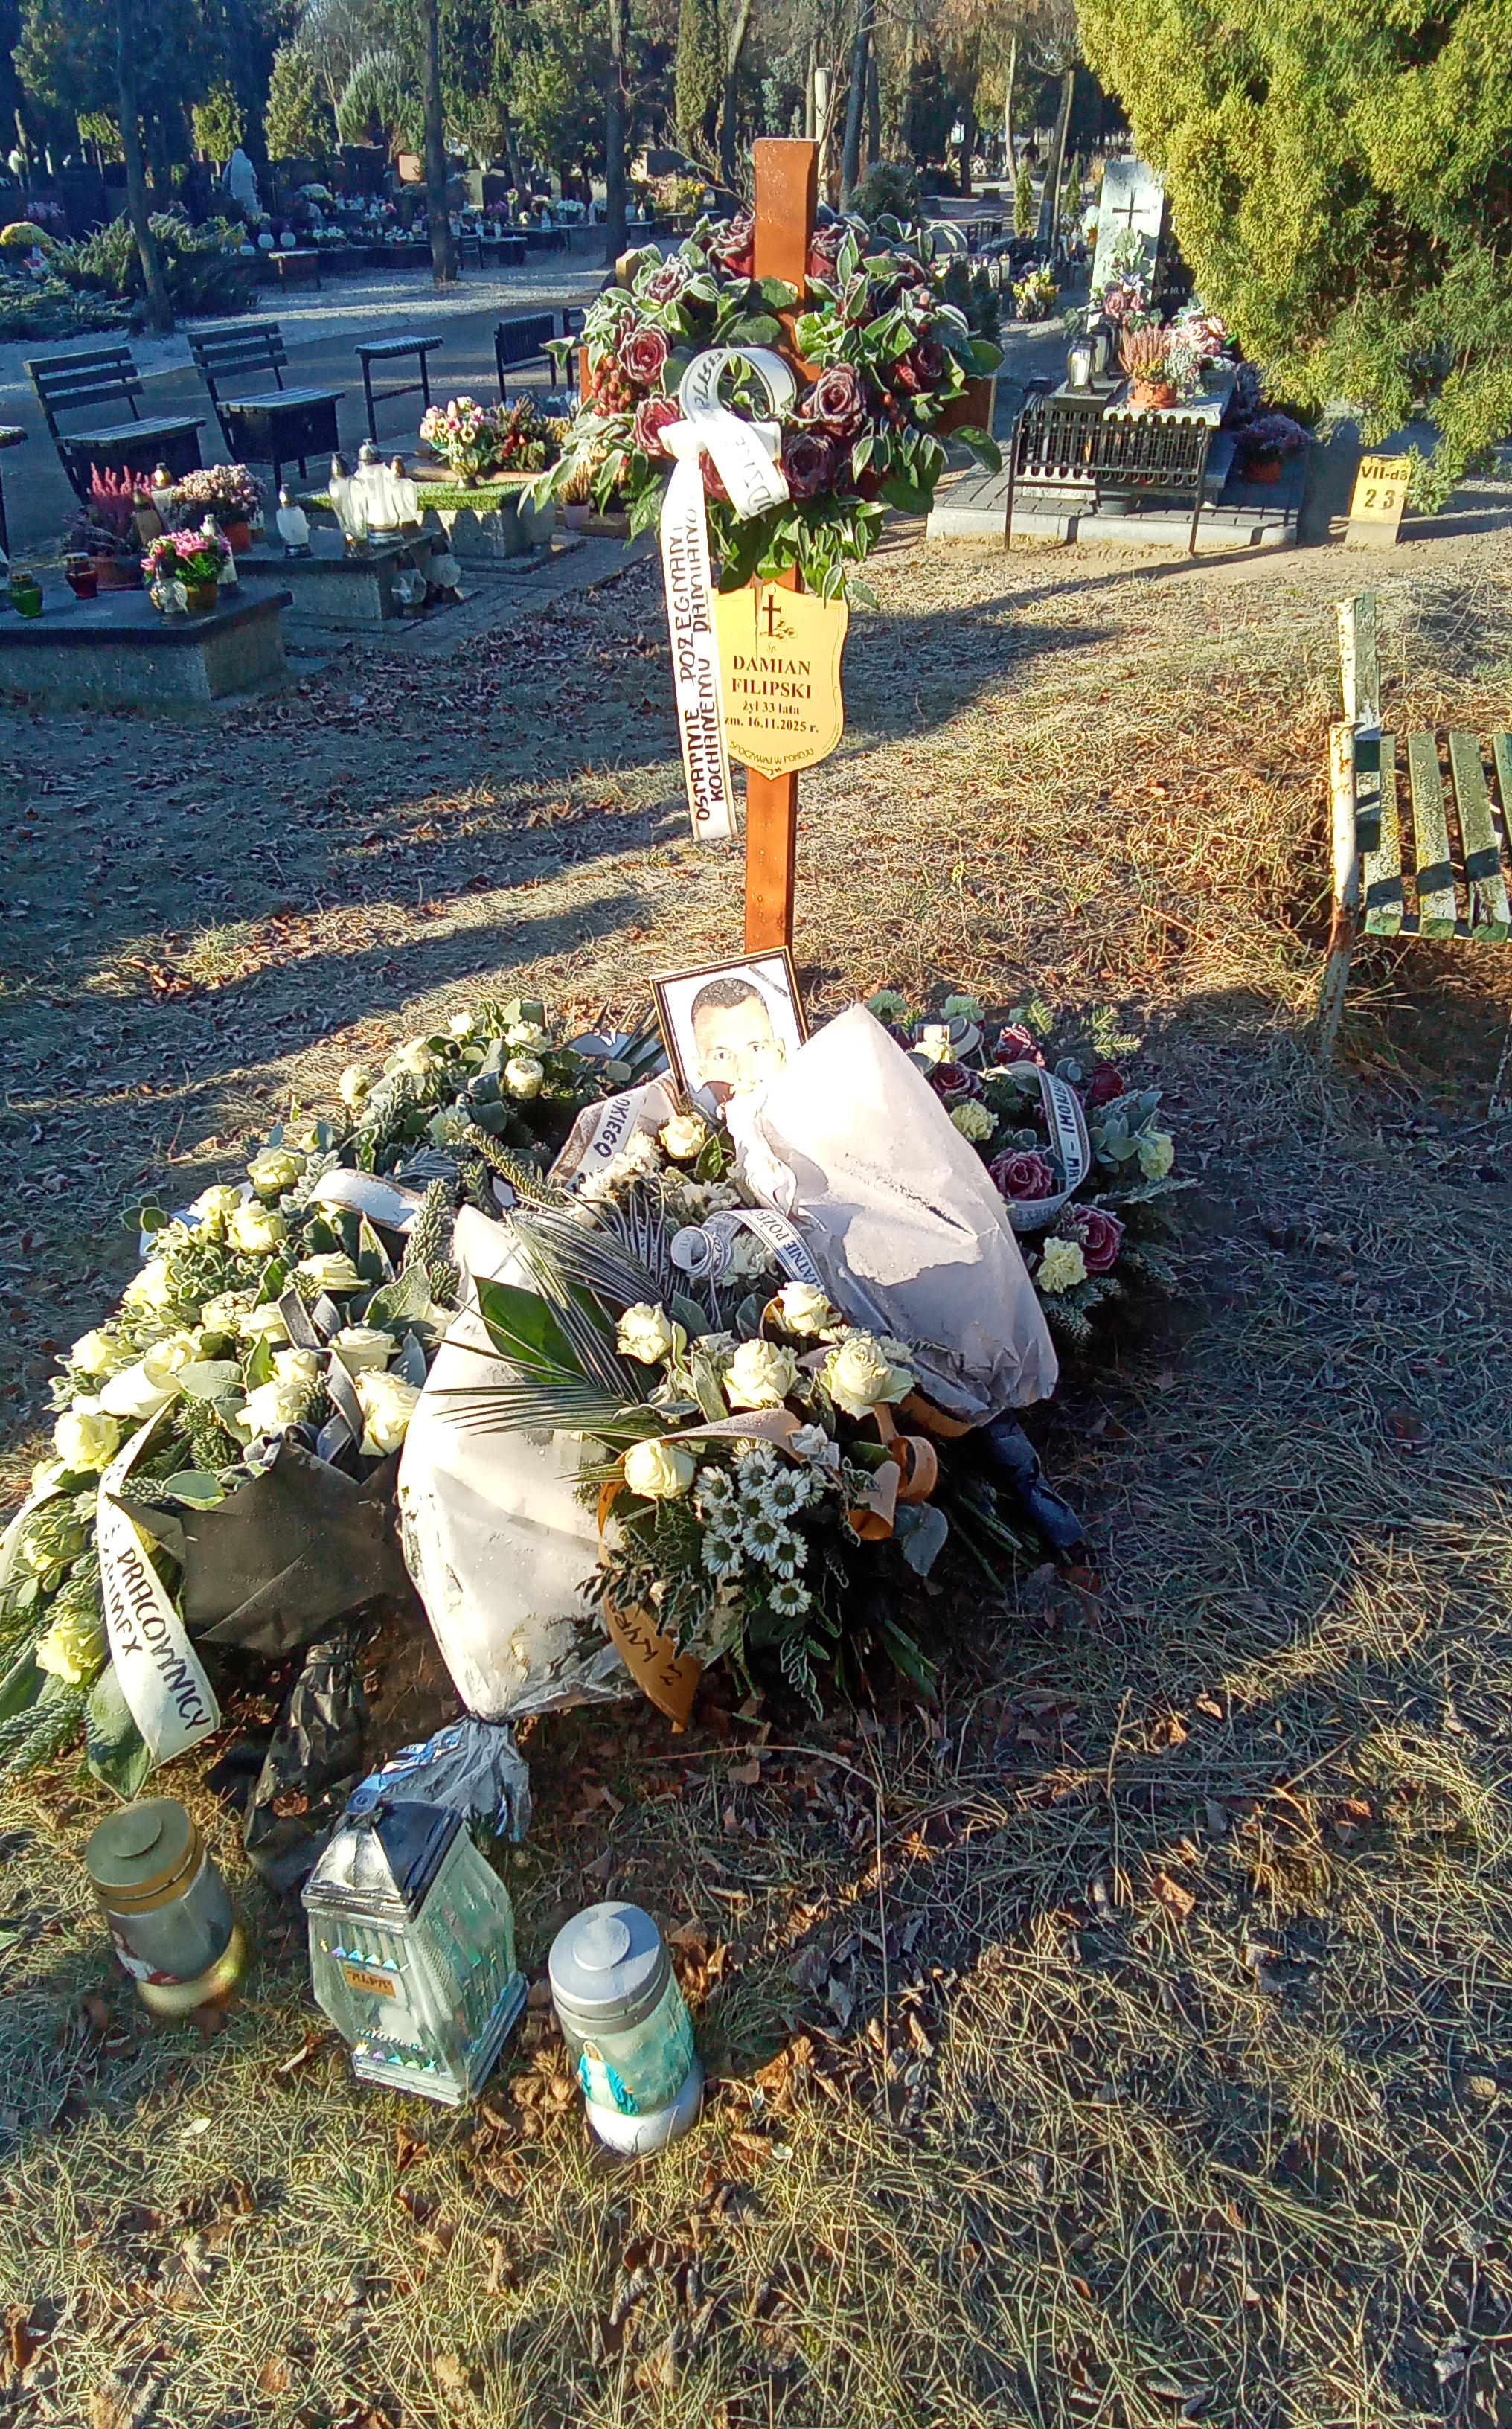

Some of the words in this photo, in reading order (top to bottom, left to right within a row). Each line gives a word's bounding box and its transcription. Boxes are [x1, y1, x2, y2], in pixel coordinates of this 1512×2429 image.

[733, 655, 811, 676] DAMIAN
[731, 678, 812, 699] FILIPSKI
[724, 717, 744, 727] zm.
[748, 717, 807, 732] 16.11.2025
[810, 723, 819, 733] r.
[743, 700, 759, 714] żył
[762, 702, 775, 712] 33
[778, 703, 800, 715] lata
[698, 657, 724, 801] KOCHANEMU
[685, 708, 711, 821] OSTATNIE
[784, 1234, 821, 1287] TATNIE
[117, 1546, 211, 1731] PRACOWNICY
